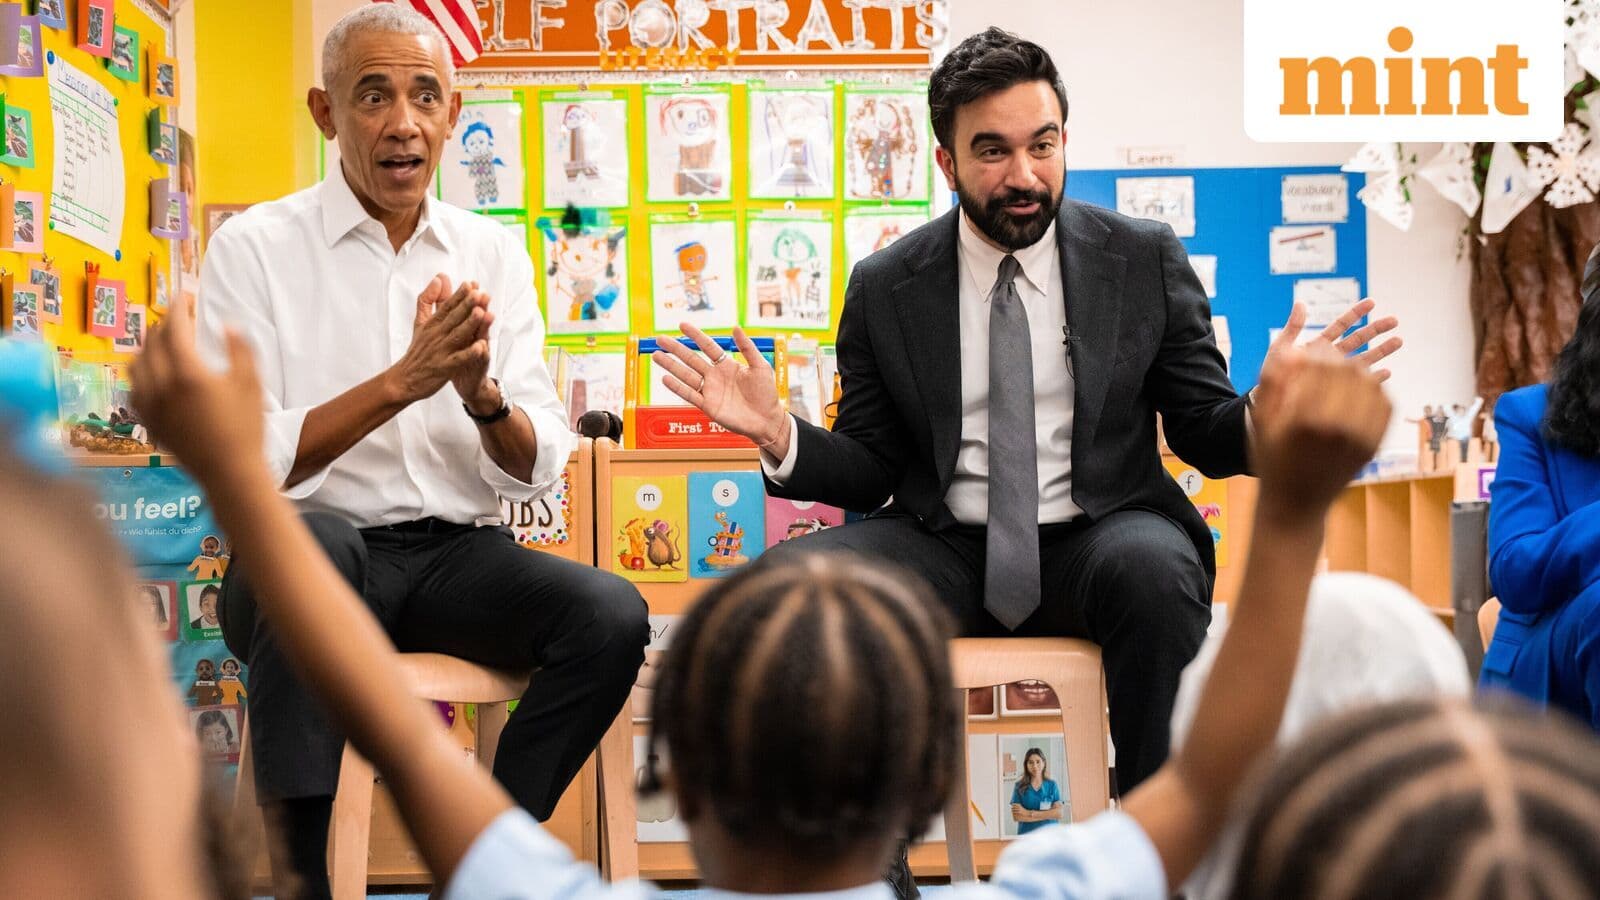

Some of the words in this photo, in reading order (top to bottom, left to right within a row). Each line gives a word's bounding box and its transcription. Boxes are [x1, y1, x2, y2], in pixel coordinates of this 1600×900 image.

[594, 0, 948, 51] PORTRAITS
[600, 46, 740, 70] LITERACY
[668, 422, 703, 434] First
[709, 421, 730, 433] To
[1185, 474, 1194, 490] f
[643, 492, 655, 502] m
[722, 488, 729, 498] s
[134, 496, 201, 519] feel?
